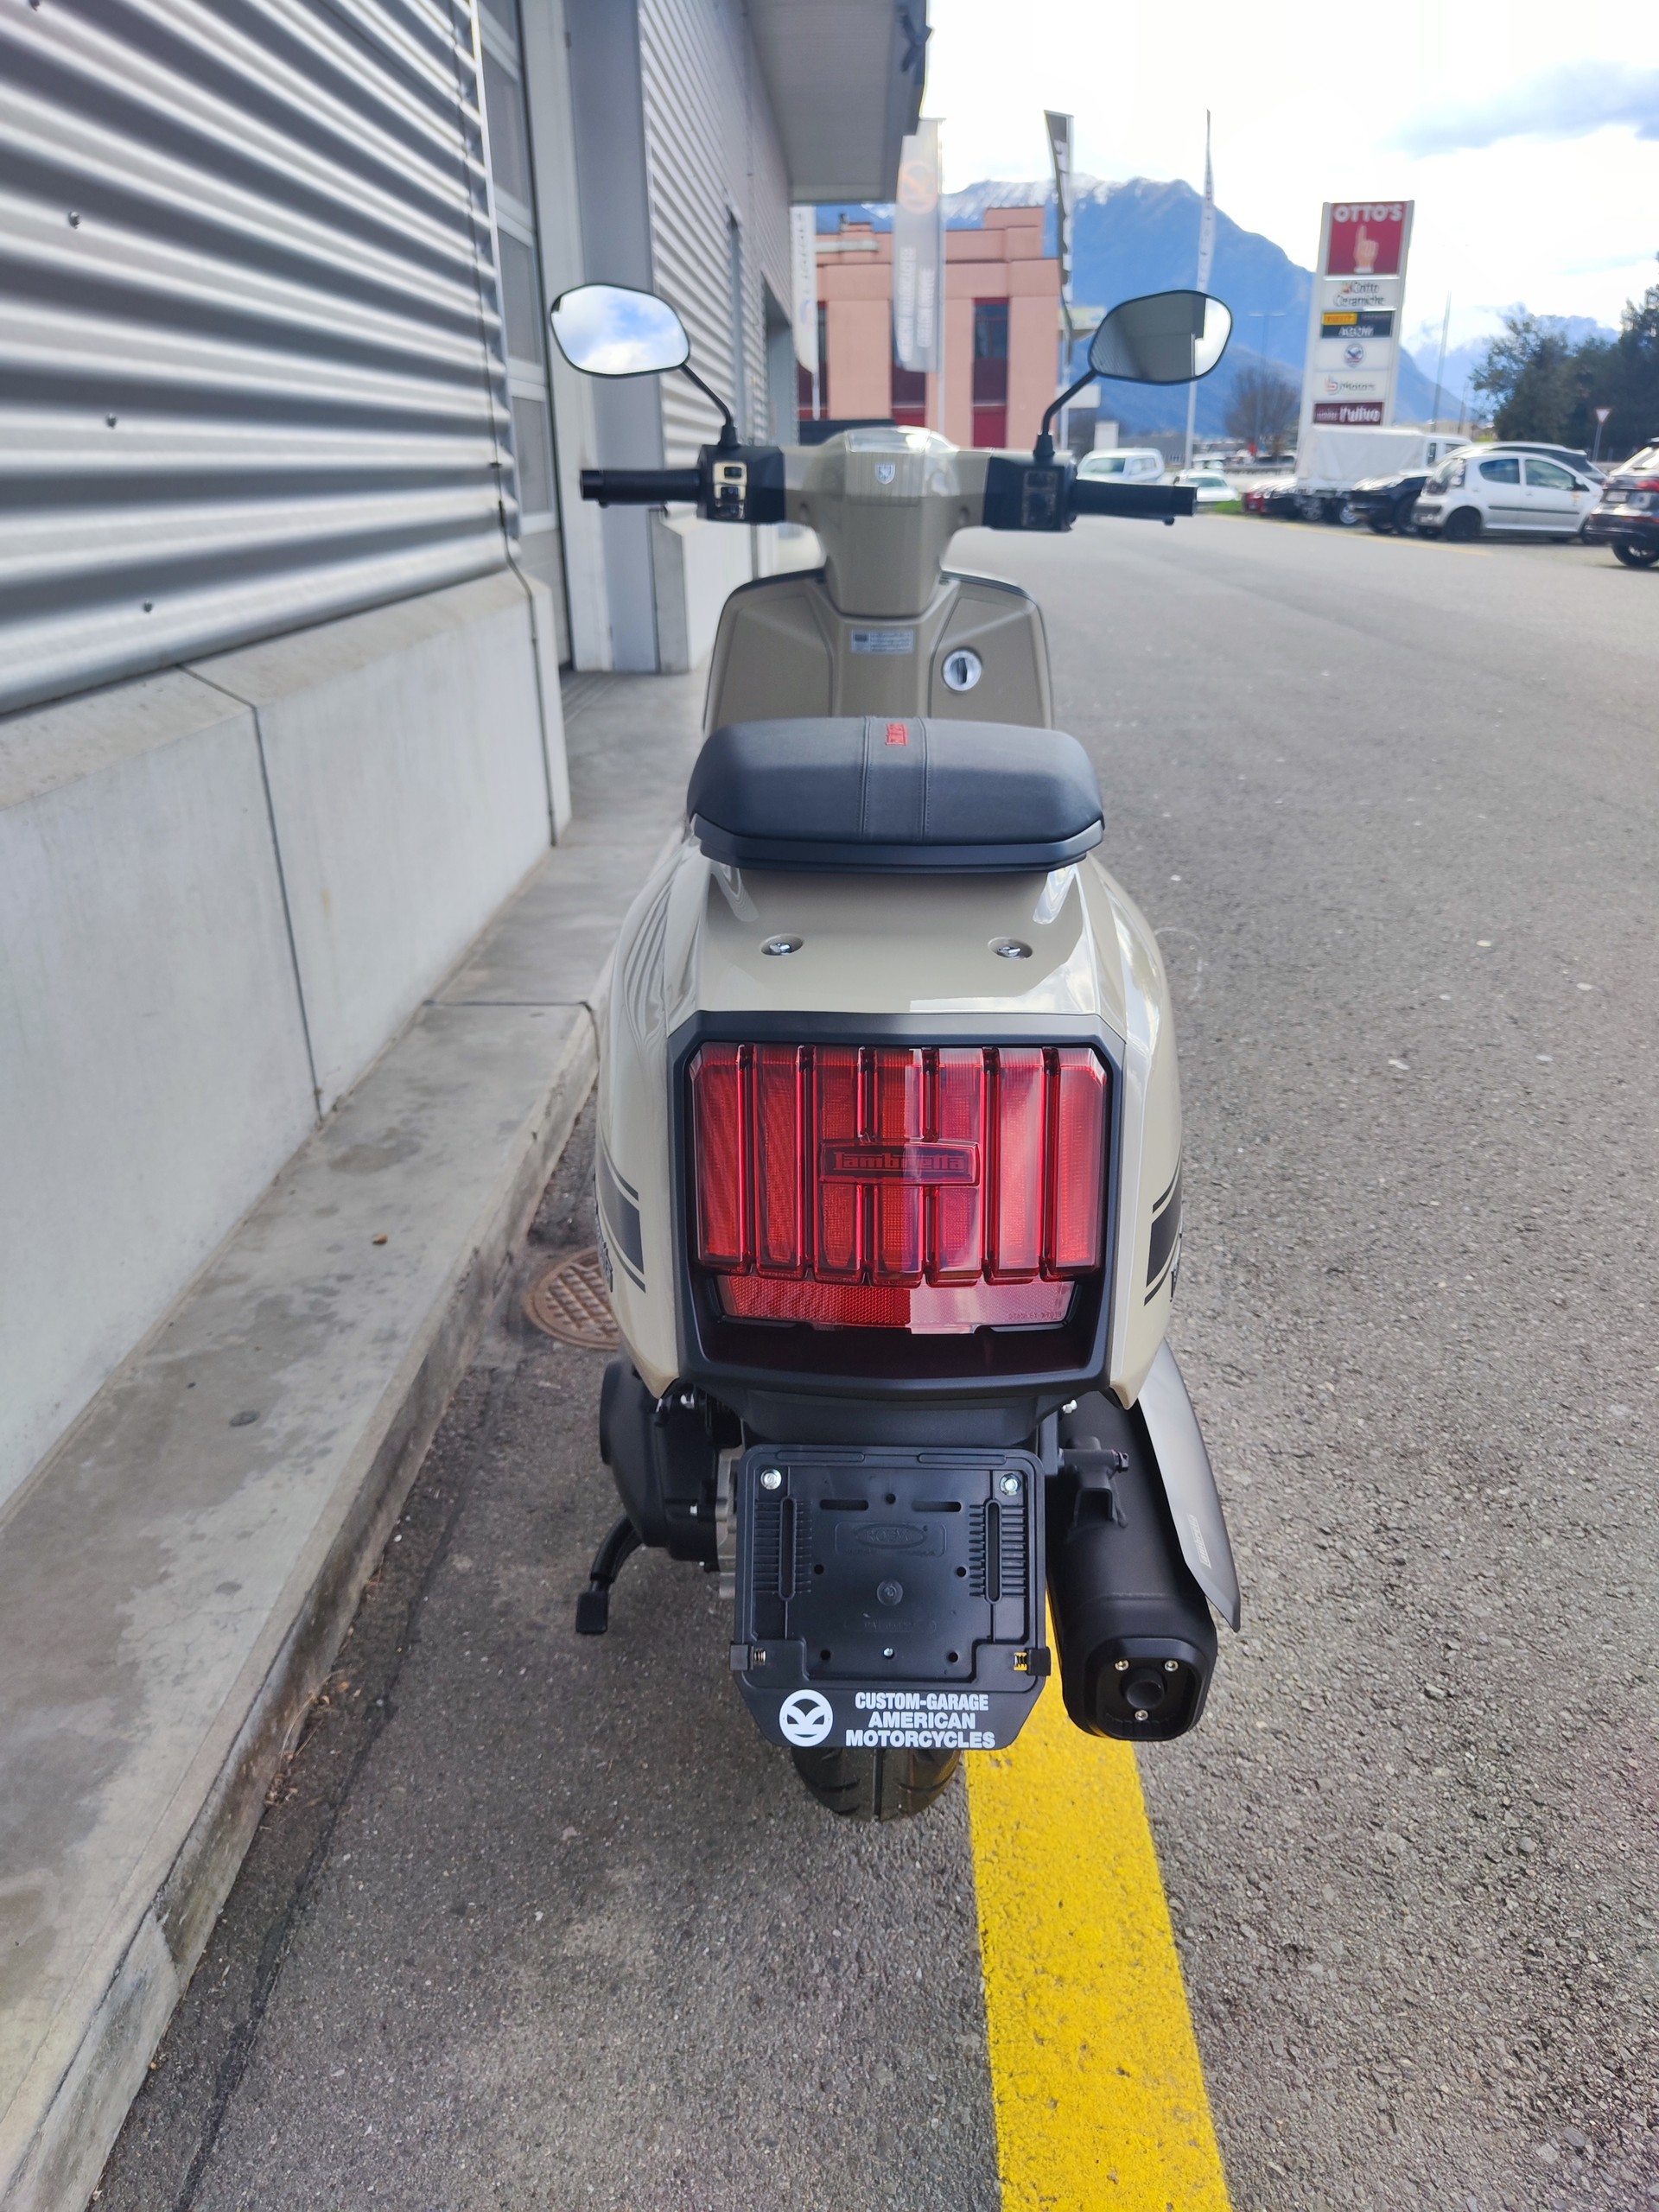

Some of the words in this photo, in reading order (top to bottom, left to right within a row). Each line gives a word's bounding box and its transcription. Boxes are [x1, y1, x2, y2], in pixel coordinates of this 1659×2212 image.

[1333, 204, 1402, 223] OTTO'S
[855, 1692, 989, 1711] CUSTOM-GARAGE
[868, 1711, 976, 1729] AMERICAN
[845, 1729, 995, 1749] MOTORCYCLES
